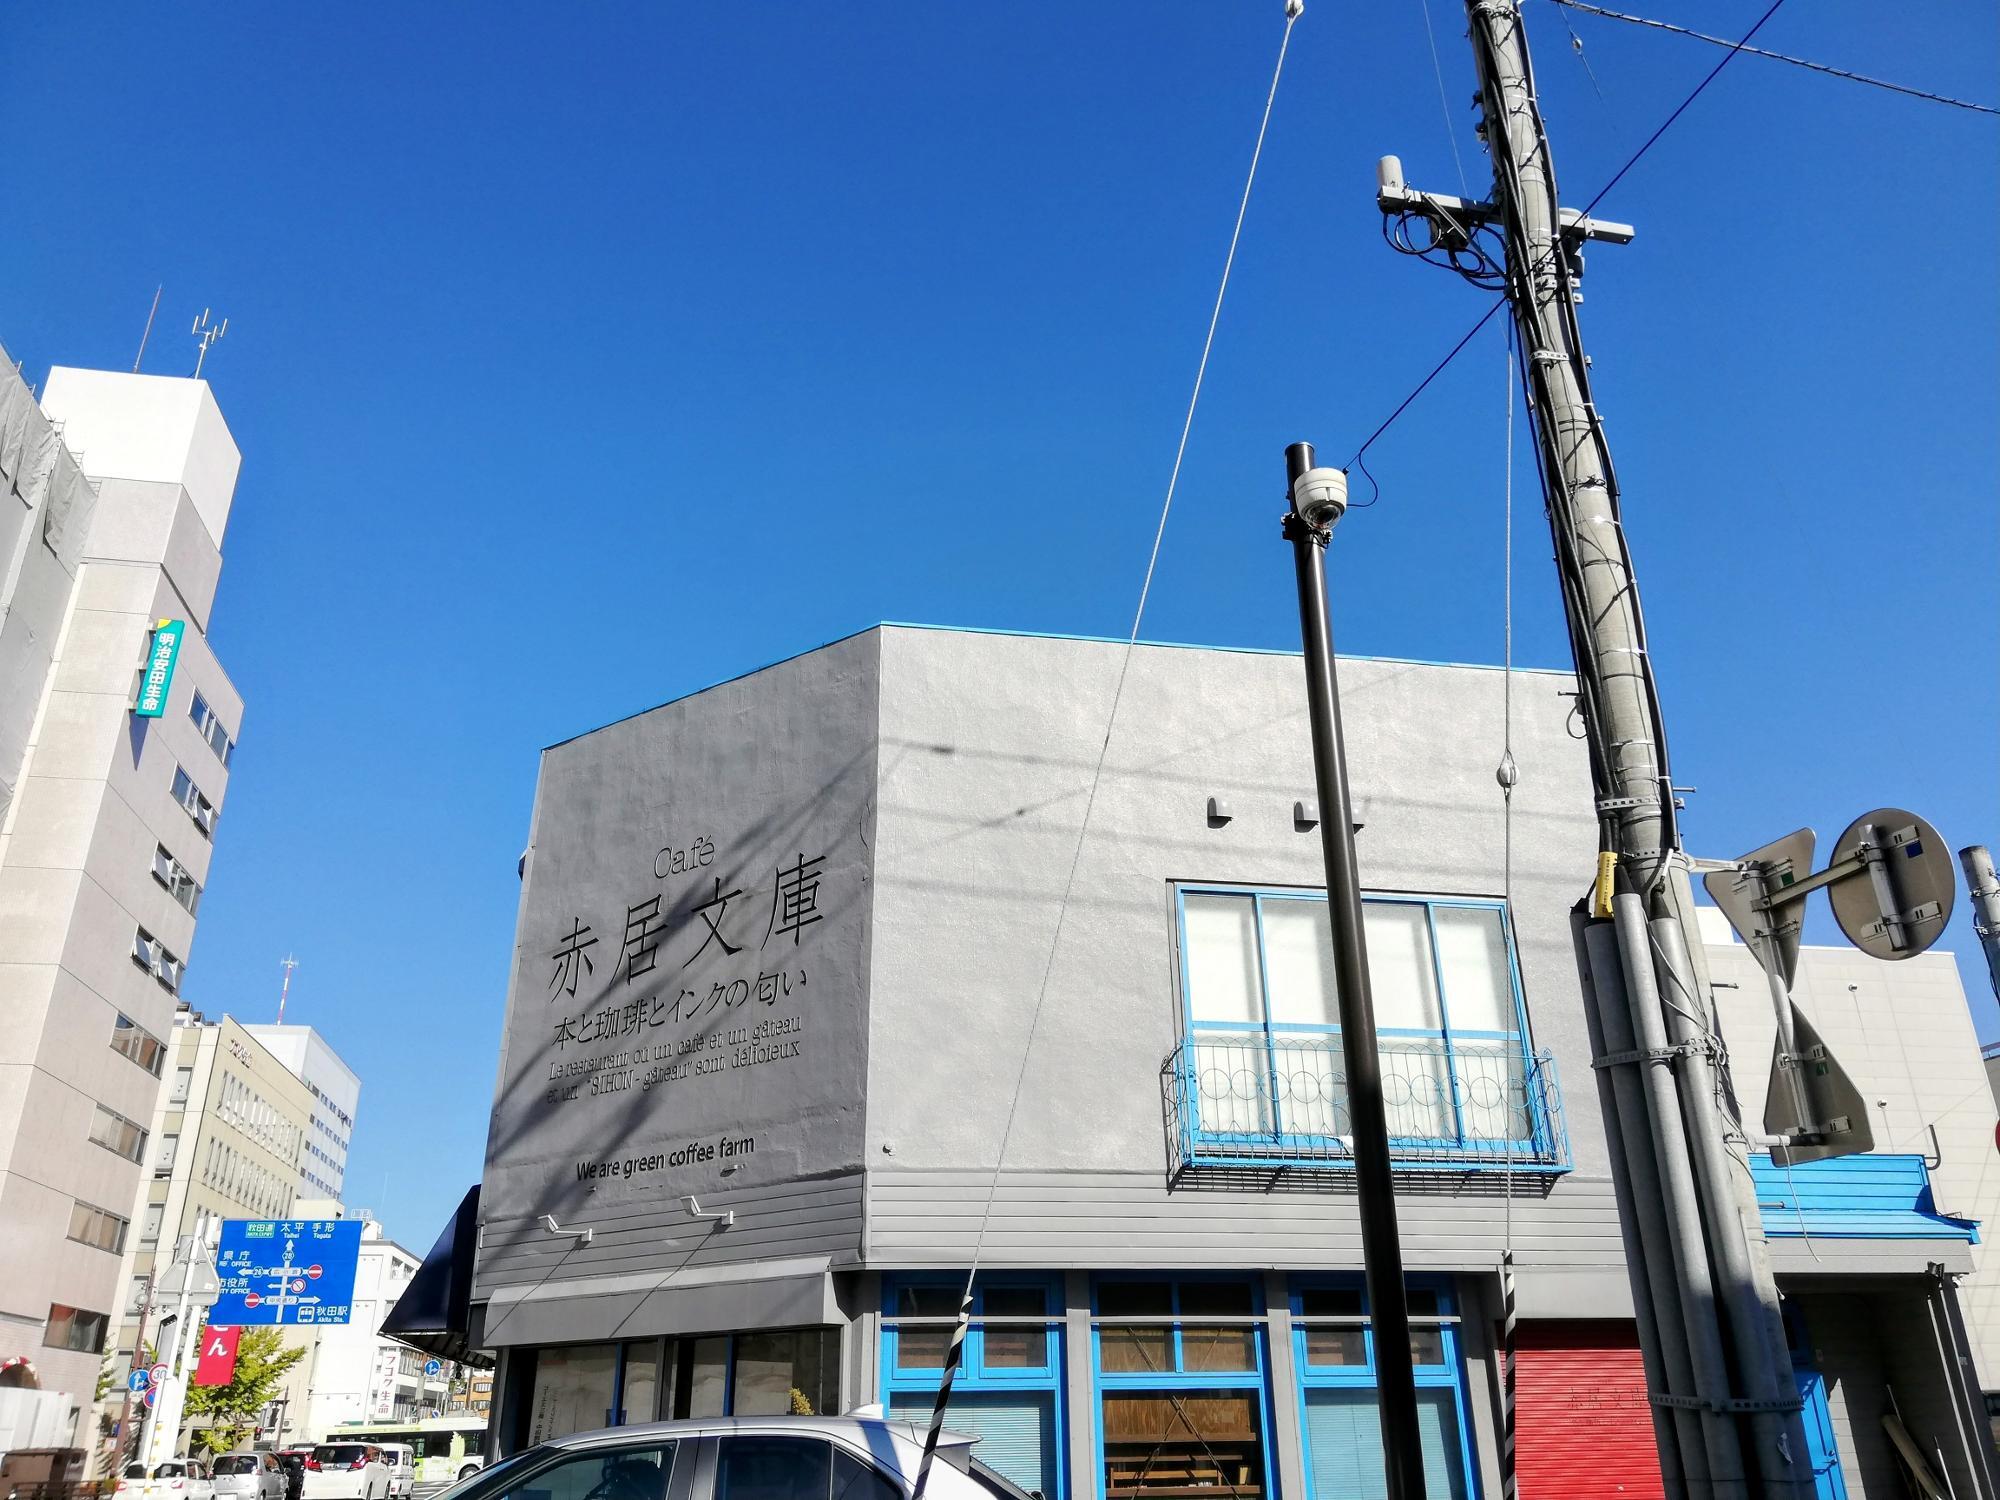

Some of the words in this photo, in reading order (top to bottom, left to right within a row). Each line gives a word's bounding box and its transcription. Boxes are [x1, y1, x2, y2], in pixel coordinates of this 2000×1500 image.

[142, 632, 175, 711] 明治安田生命
[653, 835, 716, 879] Café
[549, 853, 827, 1004] 赤居文庫
[551, 969, 807, 1050] 本と珈琲とインクの匂い
[548, 1062, 564, 1081] Le
[565, 1051, 629, 1078] restaurant
[654, 1043, 673, 1061] un
[677, 1033, 705, 1056] café
[709, 1031, 724, 1050] et
[728, 1028, 748, 1046] un
[751, 1016, 801, 1047] gâteau
[561, 1085, 579, 1102] un
[695, 1053, 726, 1076] sont
[576, 1161, 598, 1181] We
[598, 1160, 621, 1179] are
[622, 1153, 665, 1179] green
[668, 1143, 715, 1168] coffee
[719, 1136, 755, 1159] farm
[281, 1222, 305, 1232] 太平
